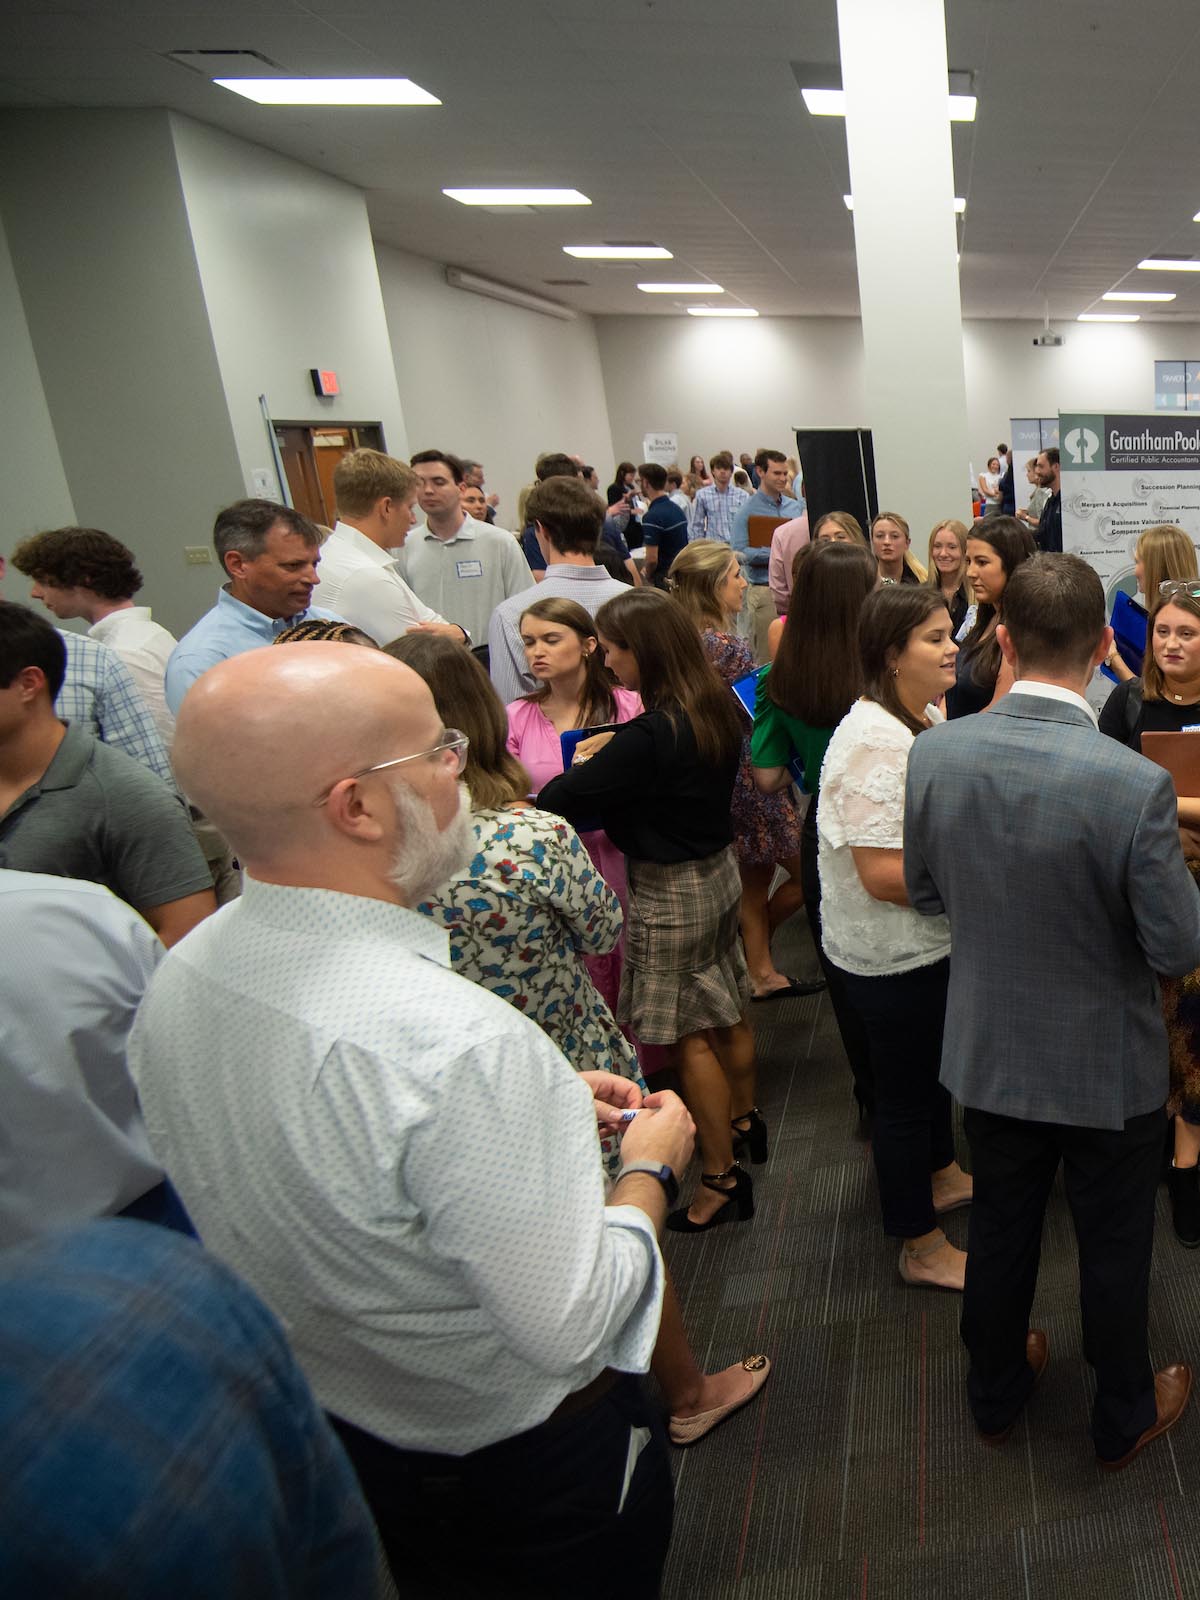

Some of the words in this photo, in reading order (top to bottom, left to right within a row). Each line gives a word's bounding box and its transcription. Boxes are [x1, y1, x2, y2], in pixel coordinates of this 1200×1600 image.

[1110, 456, 1138, 464] Certified
[1140, 456, 1160, 464] Public
[1161, 456, 1199, 464] Accountants
